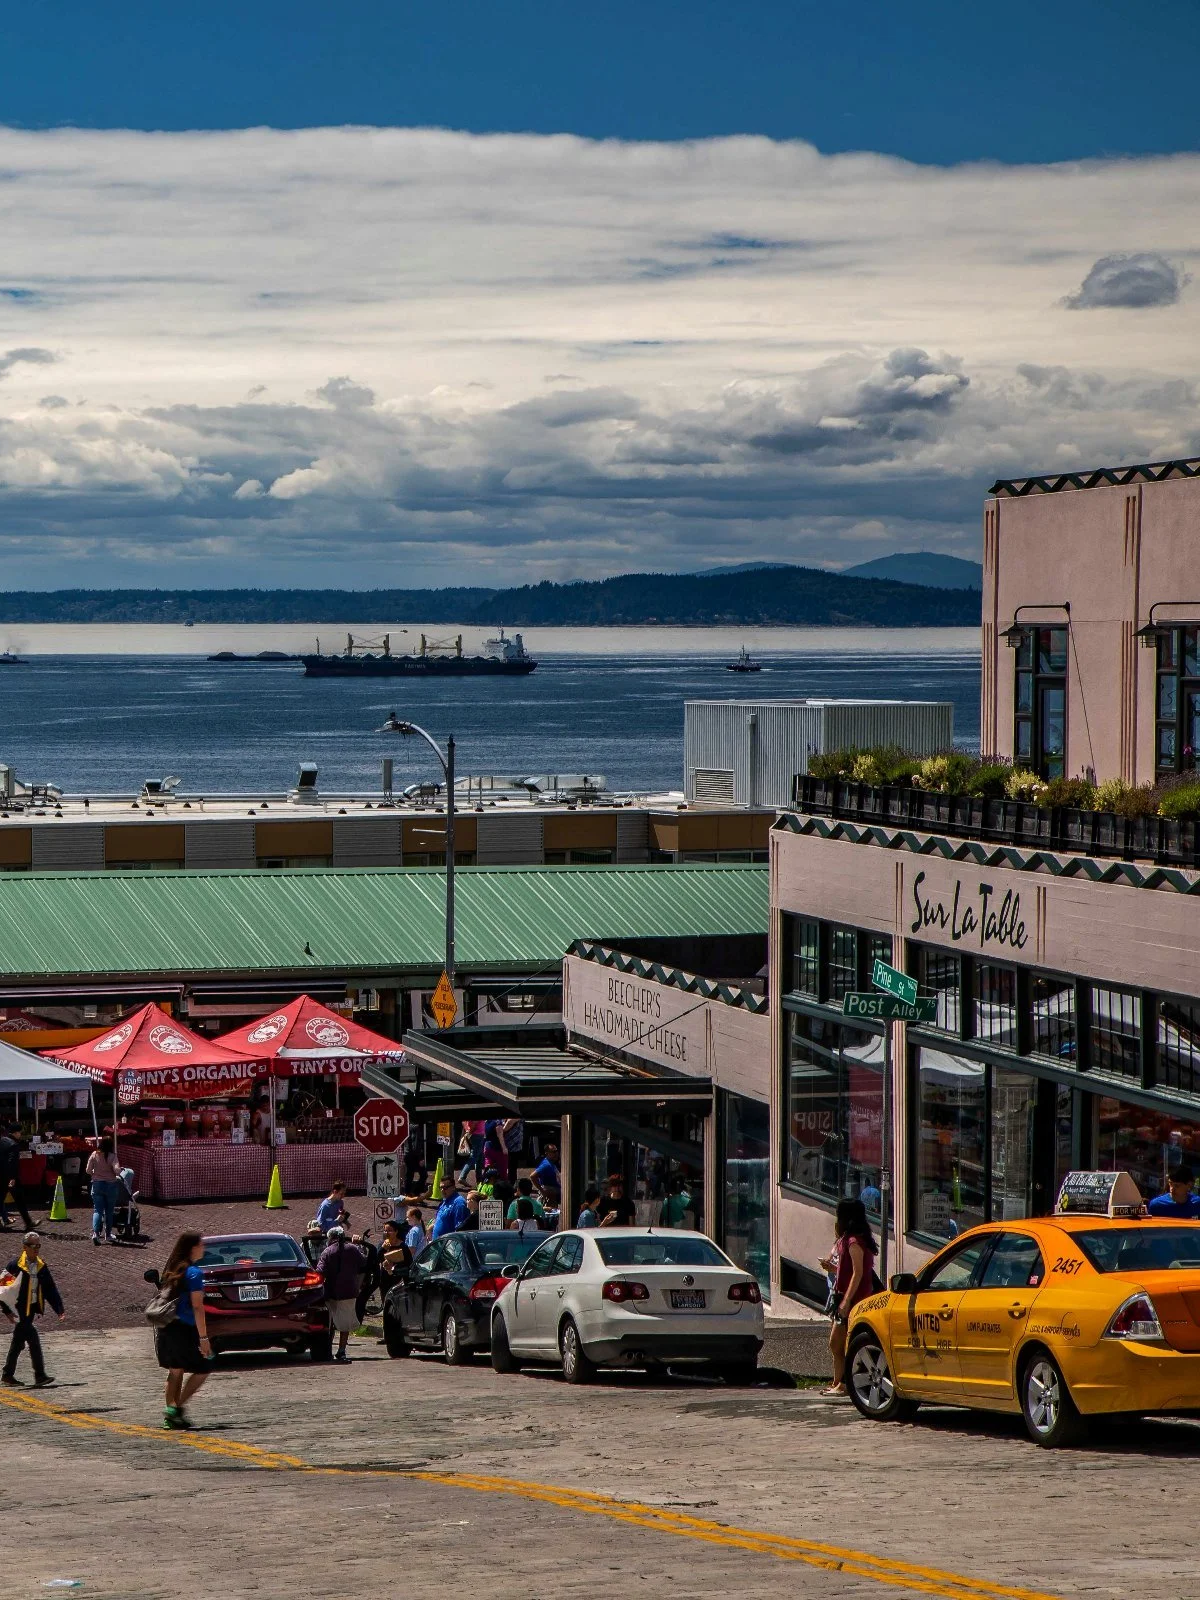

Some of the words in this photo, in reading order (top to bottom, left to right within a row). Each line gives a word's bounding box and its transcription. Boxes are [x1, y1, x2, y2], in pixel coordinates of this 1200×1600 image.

[911, 871, 950, 934] Sur
[952, 880, 979, 940] La
[979, 882, 1029, 949] Table
[876, 964, 892, 988] Pine
[897, 981, 905, 996] St
[608, 977, 661, 1019] BEECHER'S
[848, 994, 885, 1015] Post
[890, 1003, 923, 1020] Alley
[926, 1000, 936, 1008] 75
[584, 1002, 645, 1046] HANDMADE
[648, 1024, 687, 1062] CHEESE
[138, 1067, 181, 1086] INY'S
[183, 1062, 257, 1083] ORGANIC
[290, 1058, 337, 1075] TINY'S
[118, 1085, 141, 1094] APPLE
[118, 1092, 141, 1101] CIDER
[358, 1115, 405, 1137] STOP
[370, 1185, 396, 1195] ONLY
[1115, 1207, 1128, 1215] FOR
[1051, 1257, 1085, 1275] 2451
[911, 1313, 941, 1333] UNITED
